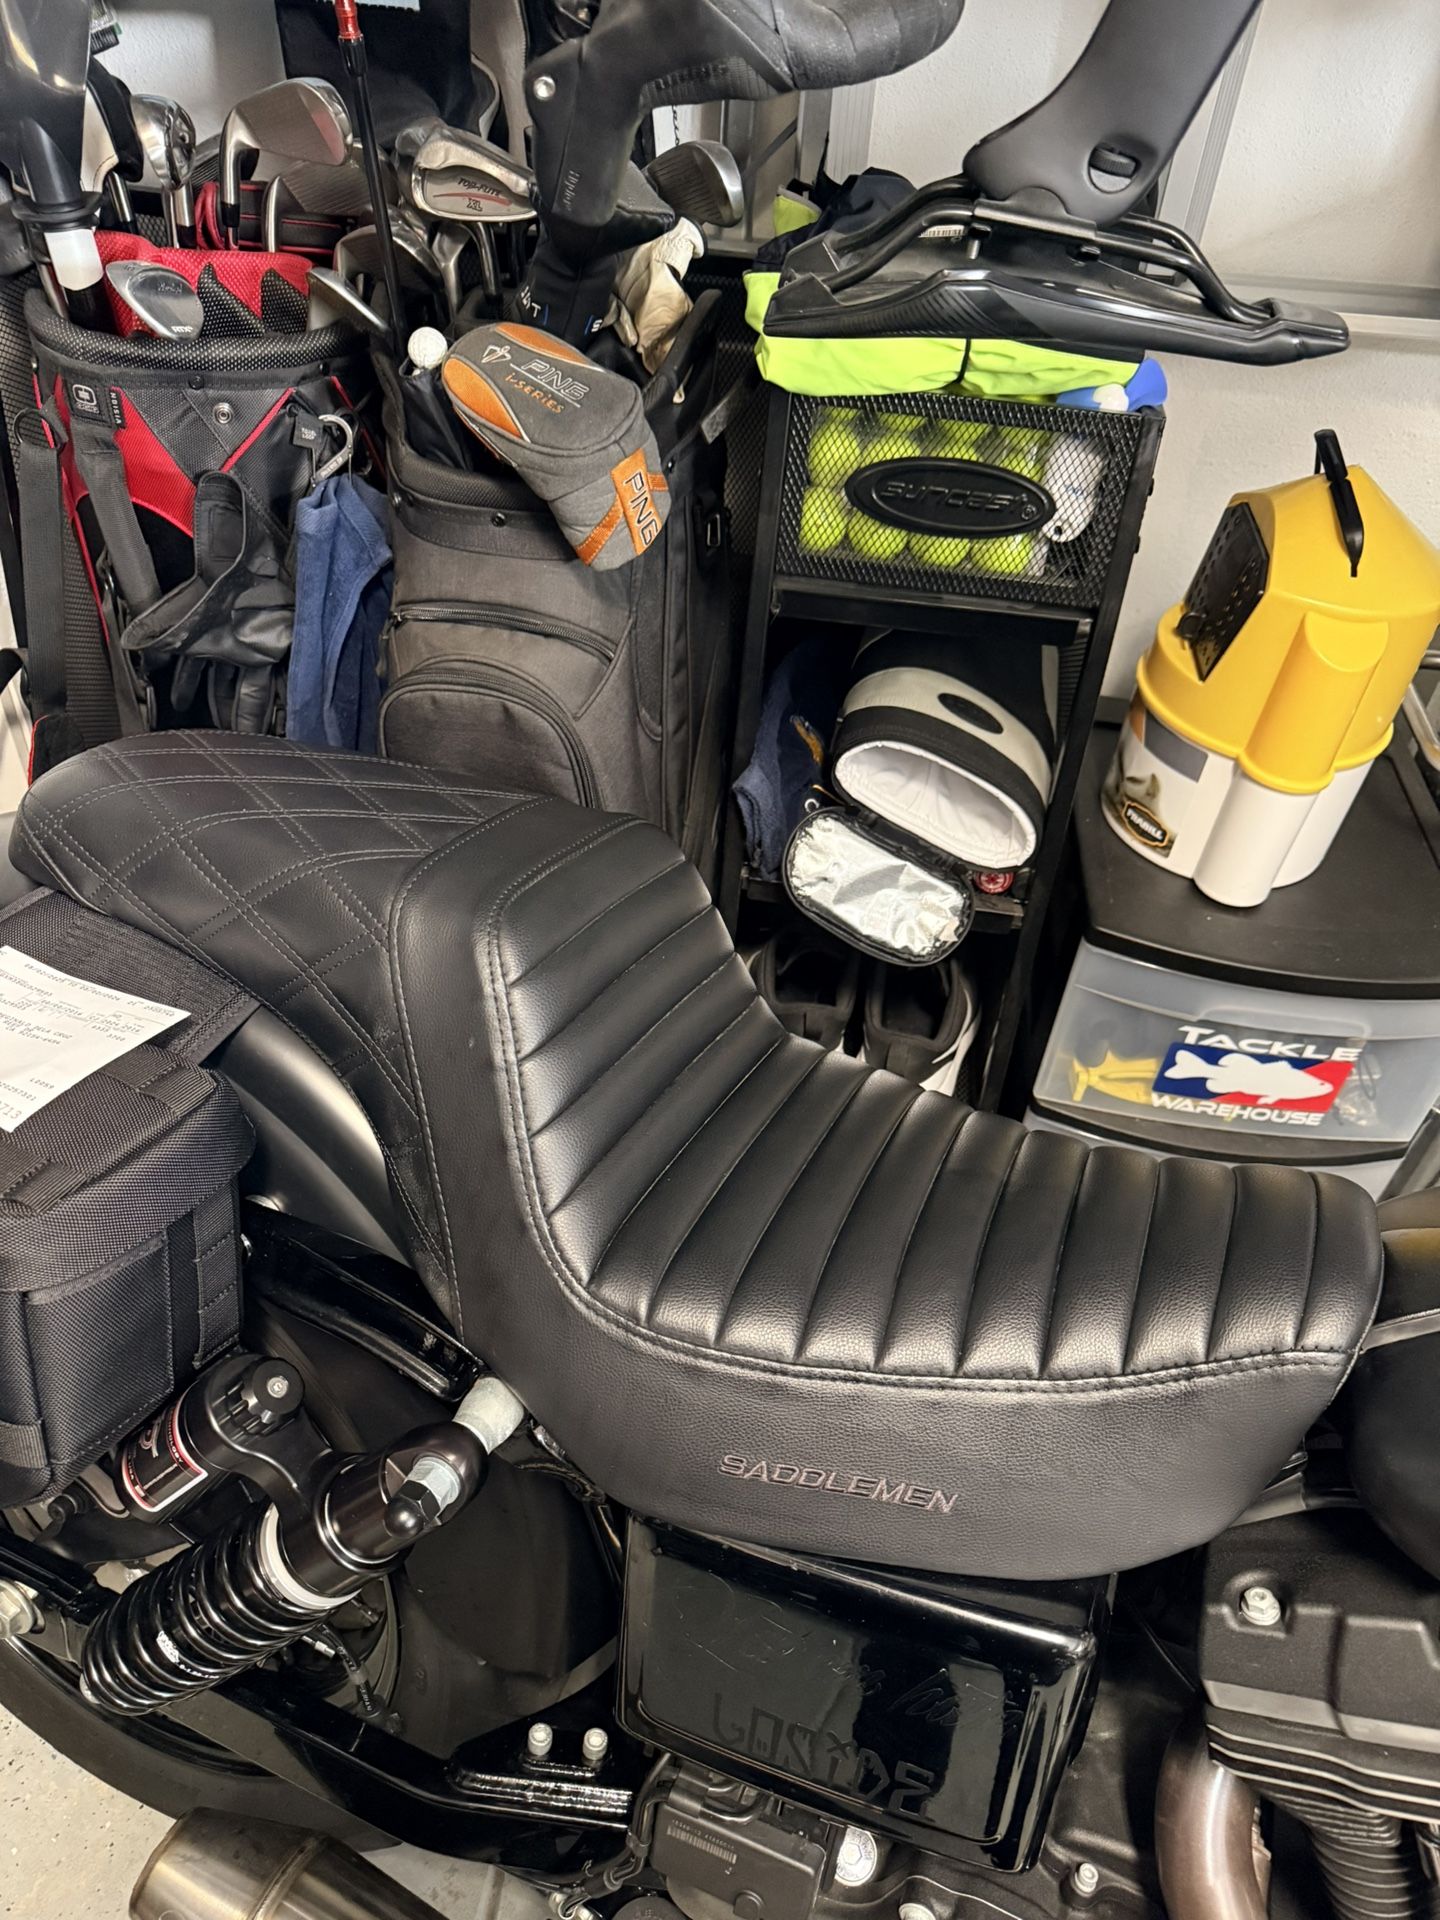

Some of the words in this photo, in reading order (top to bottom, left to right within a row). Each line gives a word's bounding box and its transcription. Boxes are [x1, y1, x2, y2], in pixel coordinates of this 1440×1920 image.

[520, 357, 590, 402] PING
[109, 391, 122, 424] VISION
[623, 470, 661, 547] PING
[1126, 807, 1164, 841] FRABILL
[1177, 1024, 1364, 1063] TACKLE
[1150, 1090, 1326, 1128] WAREHOUSE
[717, 1452, 959, 1515] SADDLEMEN
